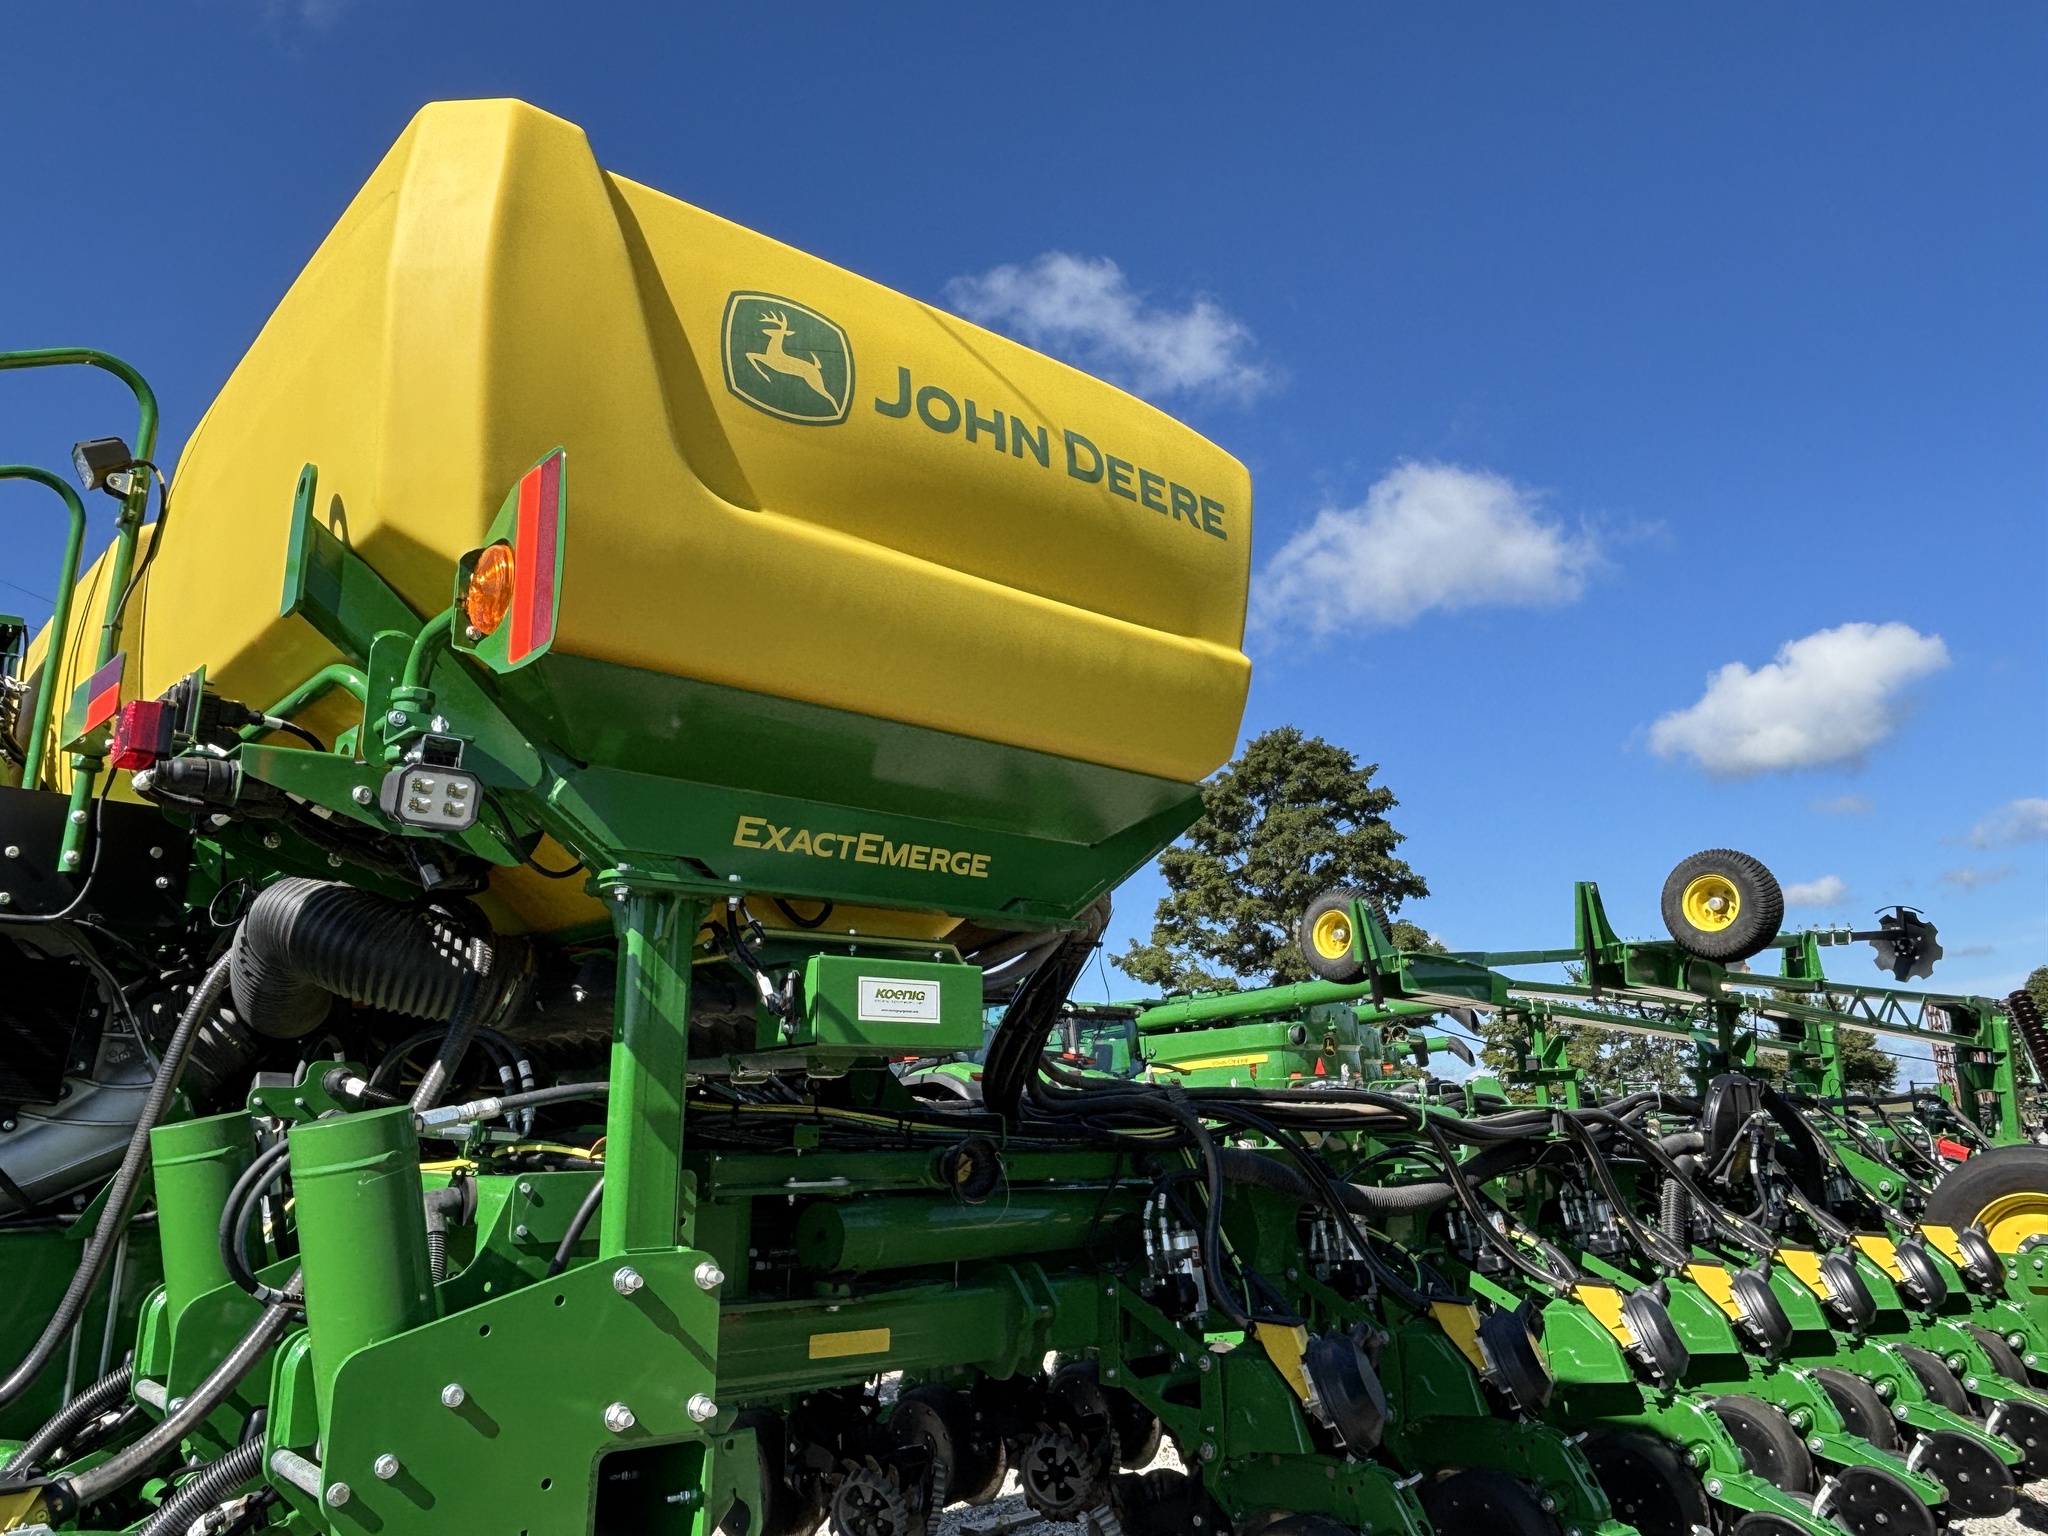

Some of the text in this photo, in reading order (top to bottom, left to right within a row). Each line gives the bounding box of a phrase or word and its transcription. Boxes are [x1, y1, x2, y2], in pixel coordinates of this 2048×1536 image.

[875, 366, 1228, 541] JOHN DEERE
[732, 815, 991, 878] EXACTEMERGE
